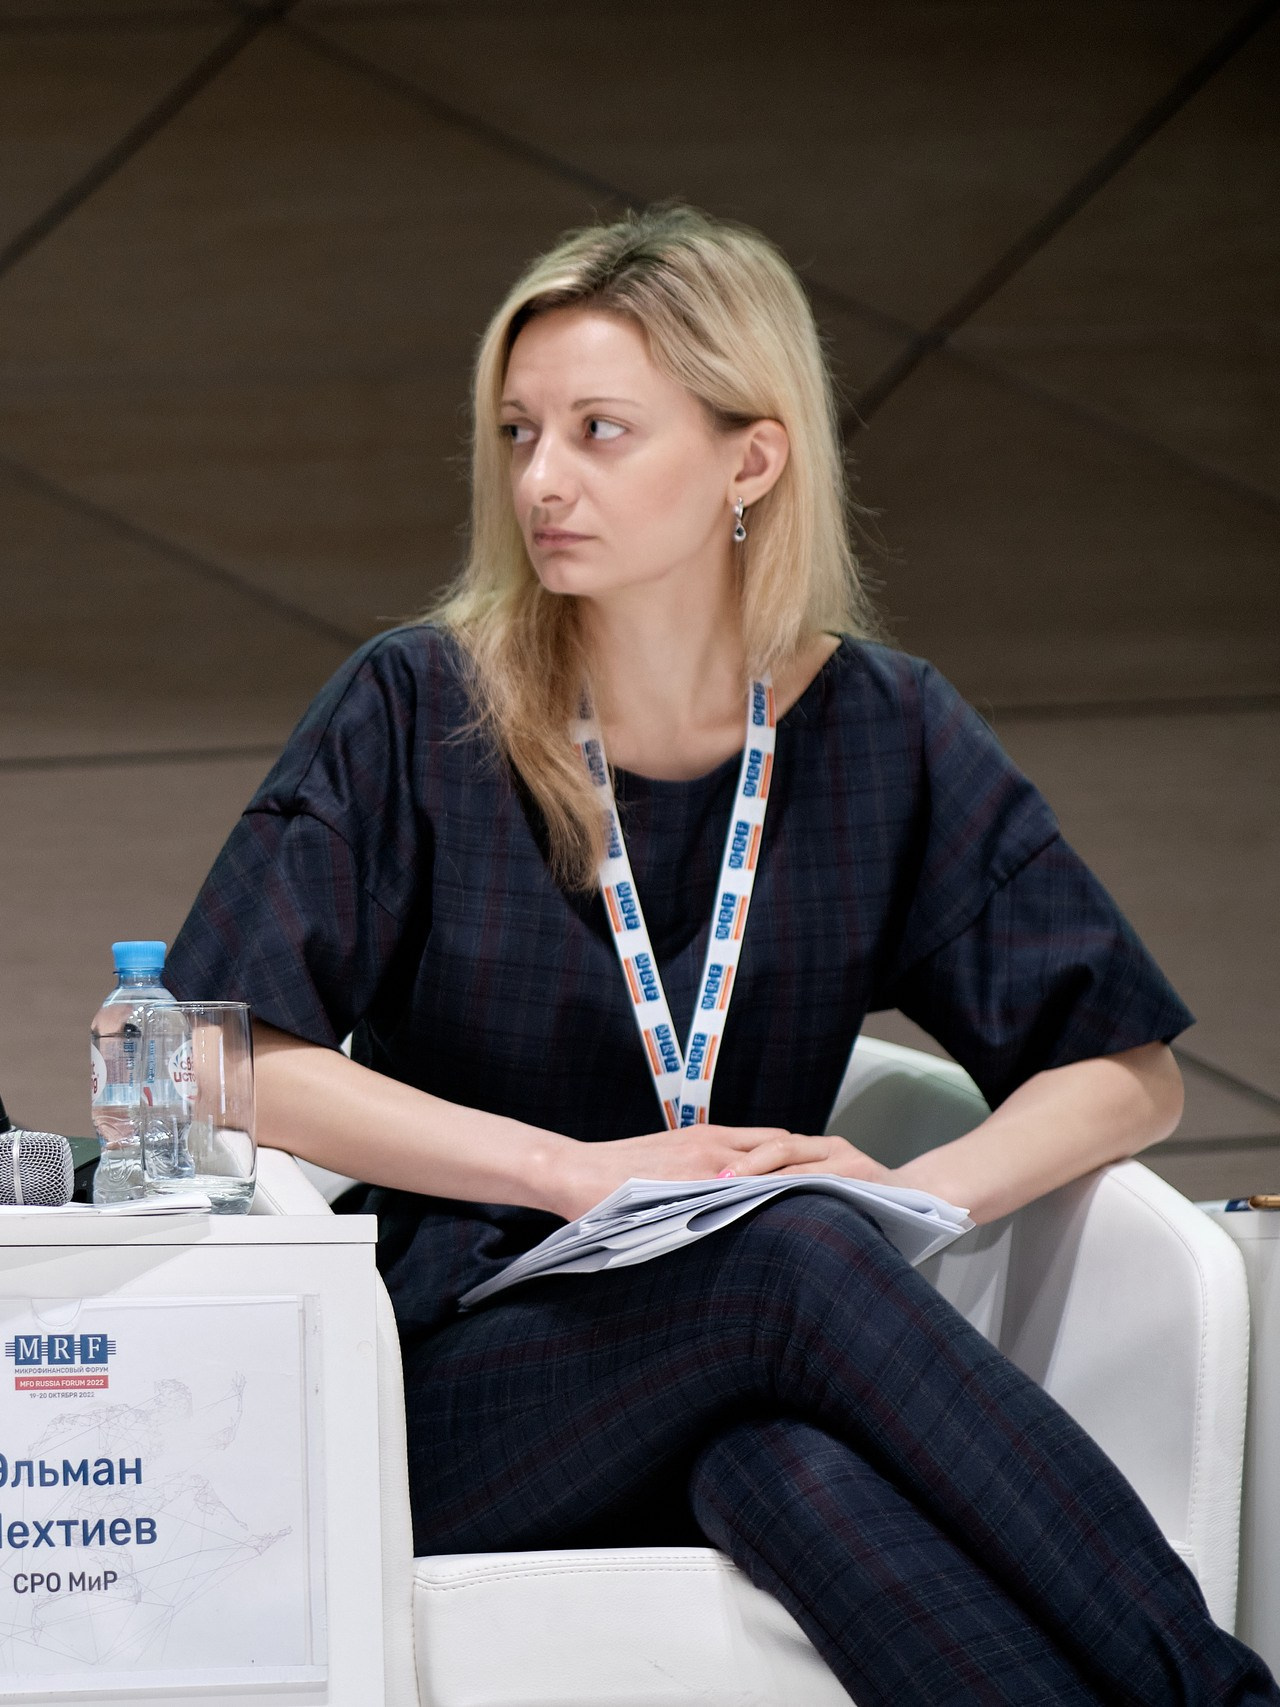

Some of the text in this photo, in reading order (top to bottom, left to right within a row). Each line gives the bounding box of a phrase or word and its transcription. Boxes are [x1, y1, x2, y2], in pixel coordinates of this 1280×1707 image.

[716, 893, 736, 939] MRF
[701, 964, 723, 1010] MRF
[686, 1033, 708, 1080] MRF
[17, 1336, 104, 1361] MRF
[14, 1366, 109, 1375] МИКРОФИНАНСОВЫЙ ФОРУМ
[19, 1380, 35, 1388] MFO
[35, 1379, 61, 1387] RUSSIA
[61, 1379, 86, 1387] FORUM
[13, 1570, 119, 1594] СРО МиР
